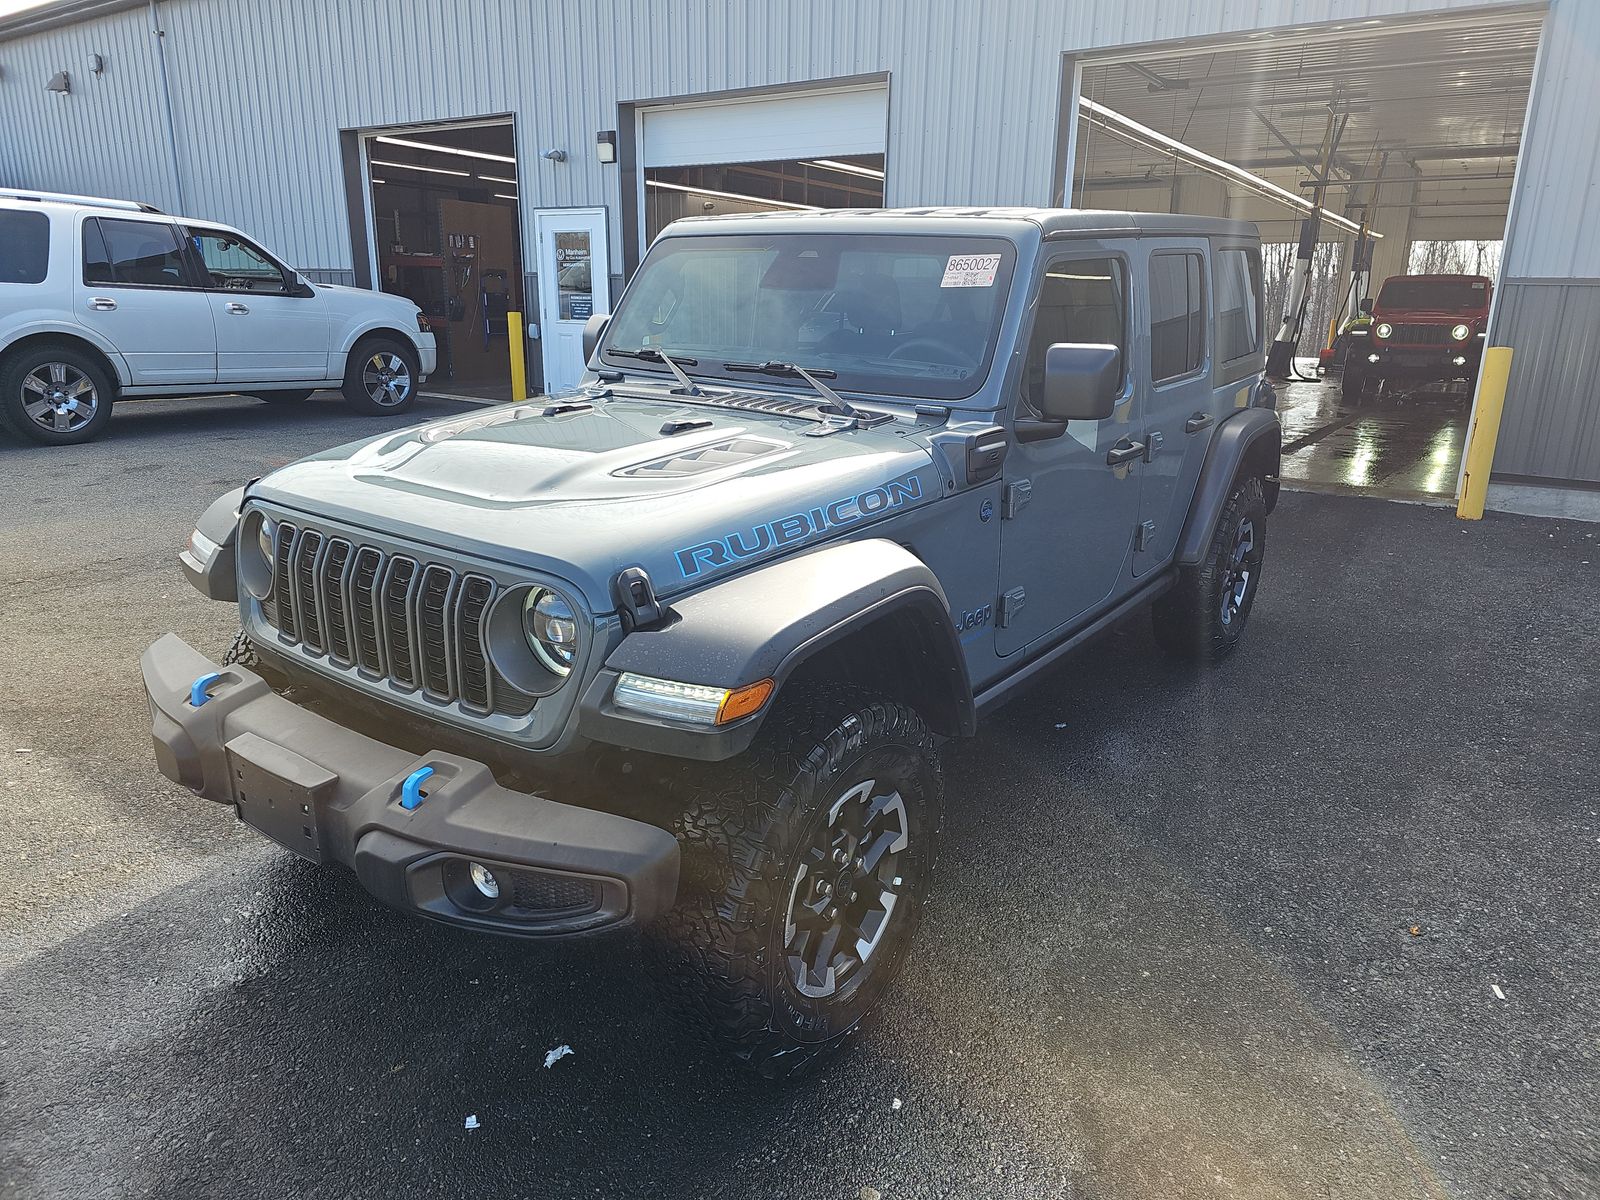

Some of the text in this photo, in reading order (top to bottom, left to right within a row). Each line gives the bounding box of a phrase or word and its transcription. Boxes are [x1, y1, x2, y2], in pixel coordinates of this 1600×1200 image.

[948, 258, 999, 271] 8650027
[674, 475, 922, 578] RUBICON
[955, 603, 992, 631] Jeep
